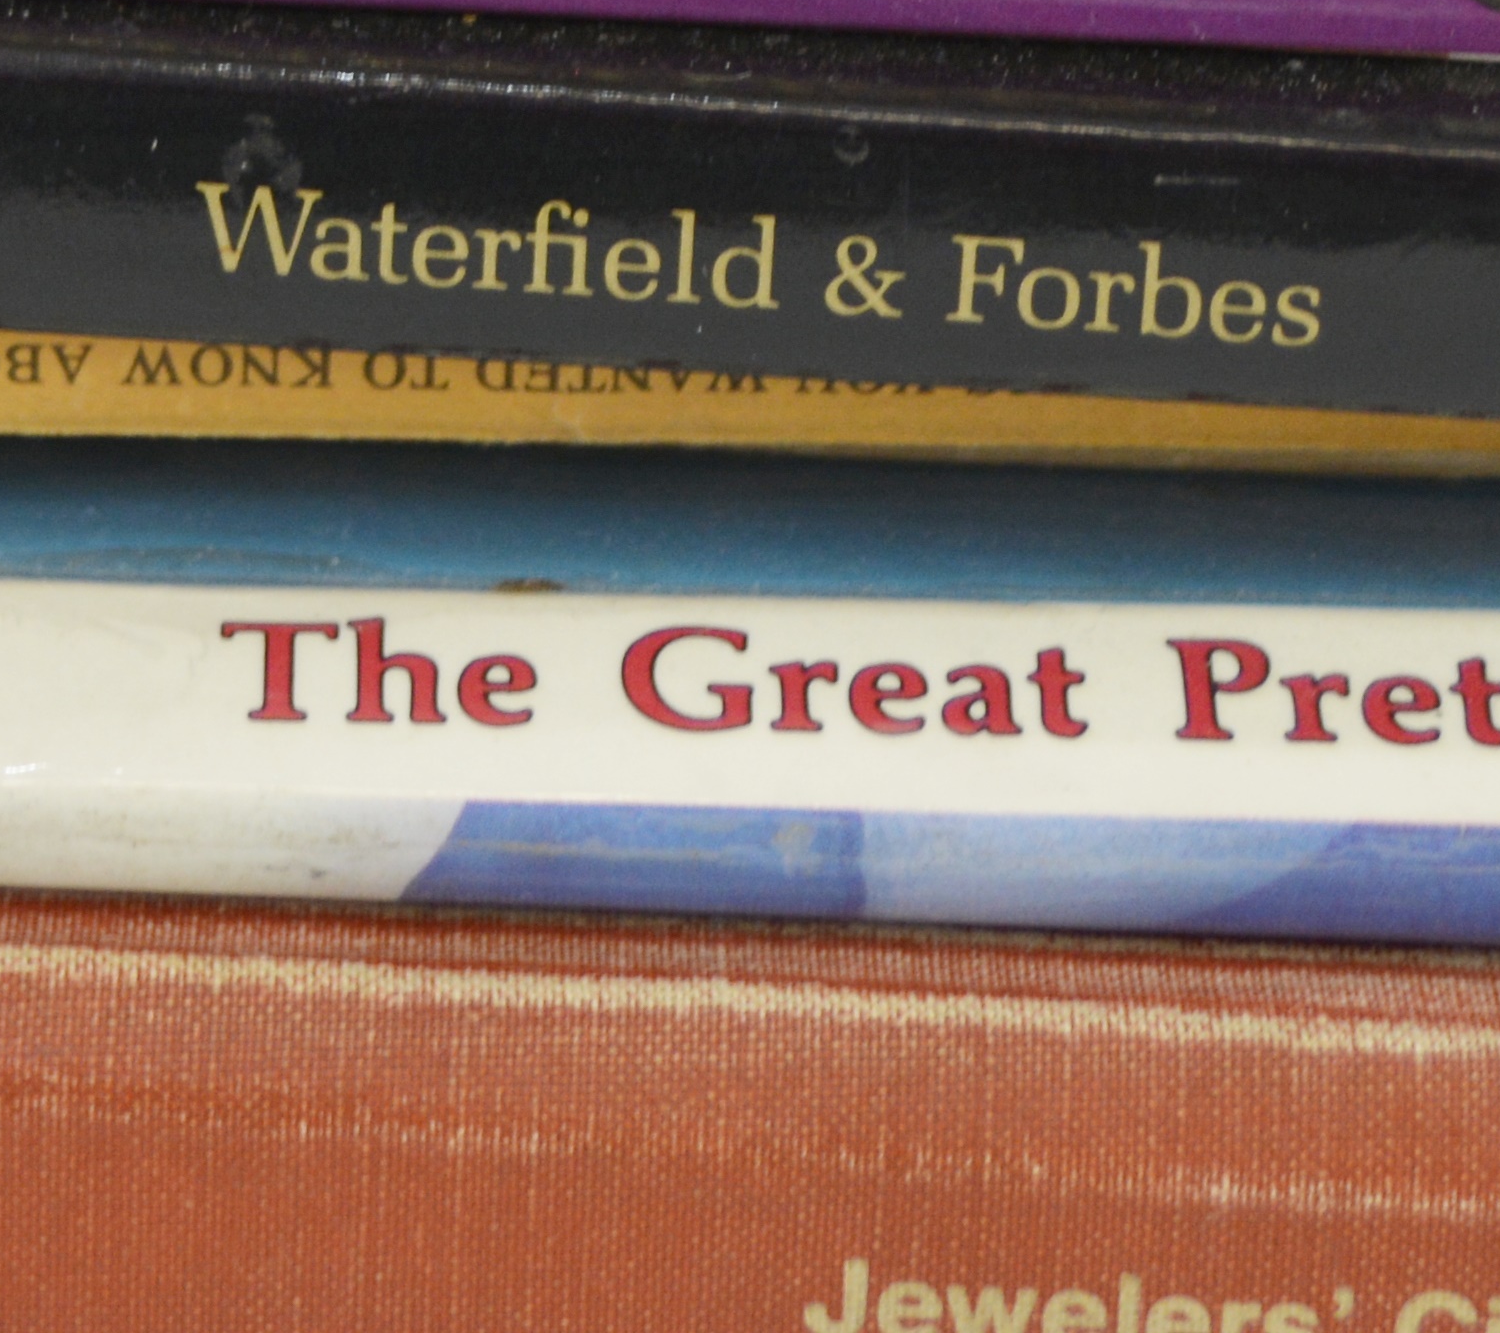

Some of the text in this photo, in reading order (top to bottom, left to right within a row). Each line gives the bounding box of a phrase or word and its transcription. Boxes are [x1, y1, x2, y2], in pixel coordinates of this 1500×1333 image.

[195, 180, 1324, 349] Waterfield & Forbes
[121, 341, 333, 391] KNOW
[363, 347, 450, 391] TO
[219, 618, 539, 730] The
[621, 625, 1092, 741] Great
